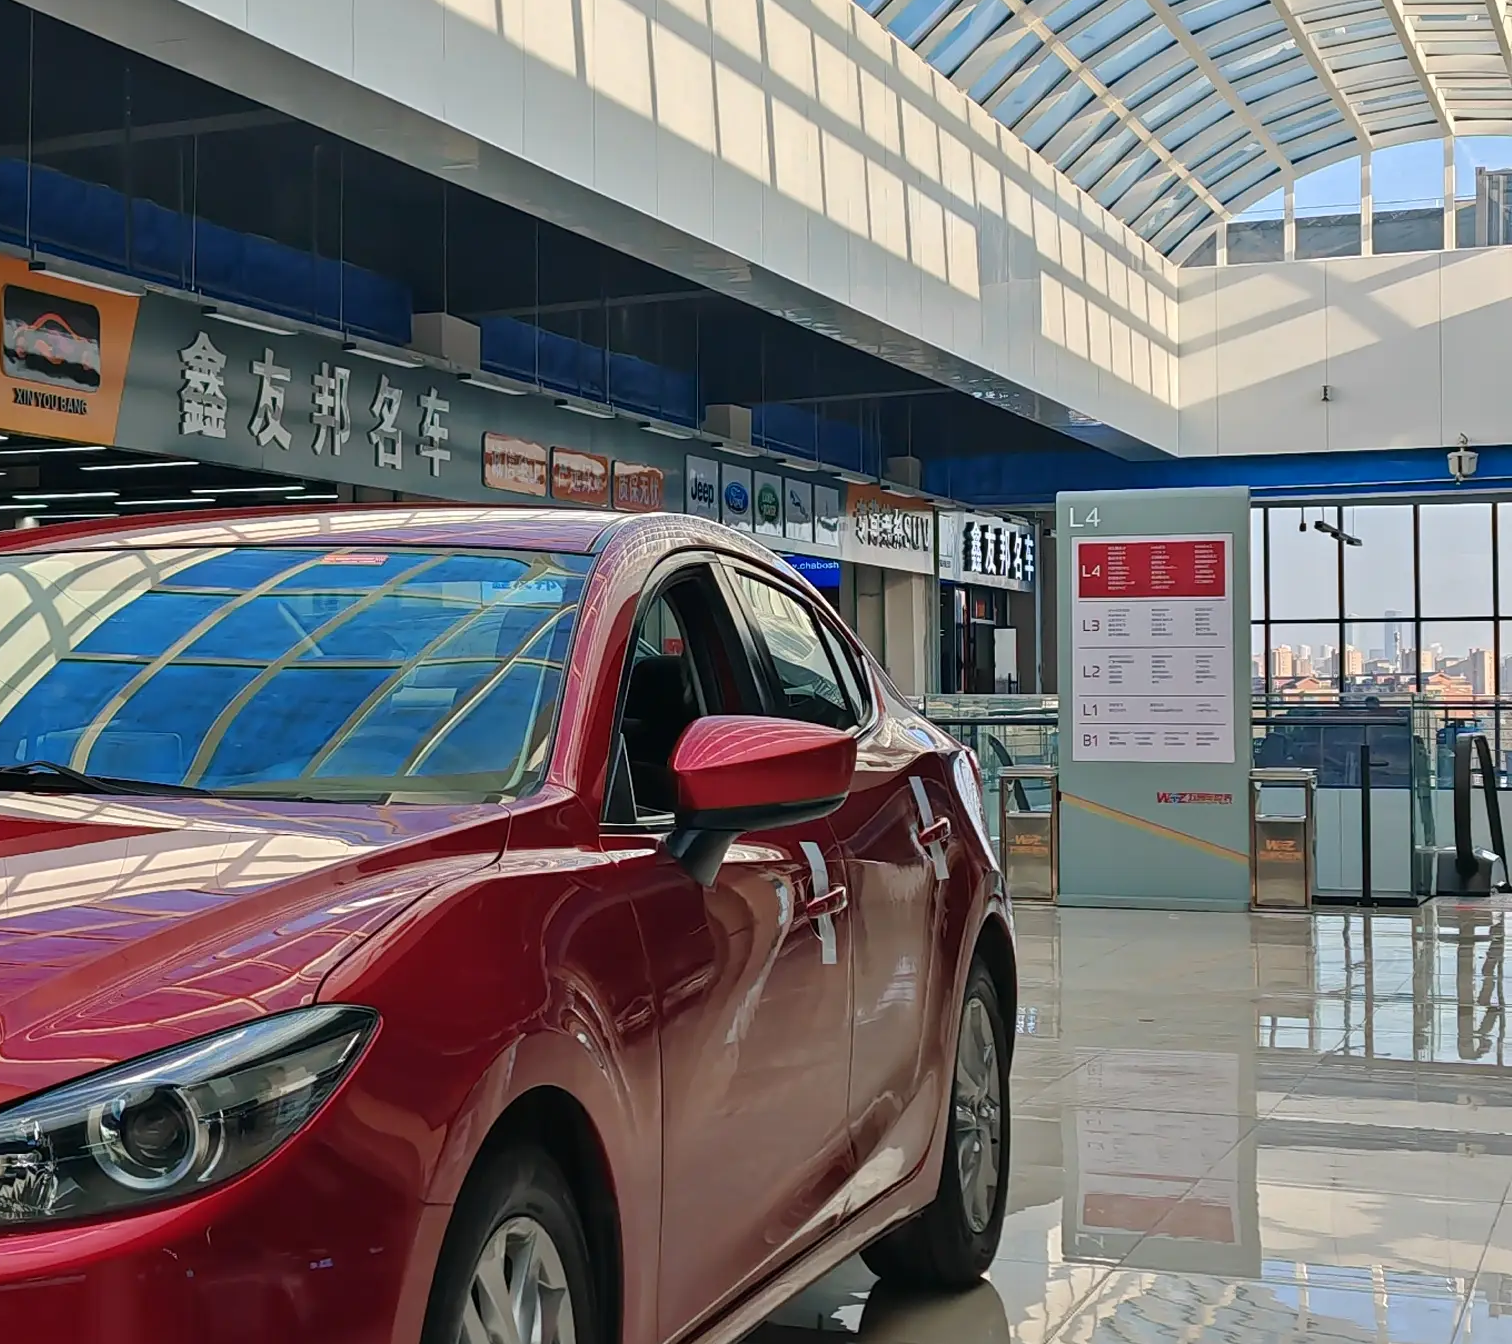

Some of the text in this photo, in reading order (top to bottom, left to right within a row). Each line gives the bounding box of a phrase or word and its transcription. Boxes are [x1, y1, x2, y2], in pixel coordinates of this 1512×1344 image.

[13, 387, 88, 415] XIN YOU BANG
[178, 331, 451, 477] 鑫友邦名车
[690, 475, 715, 509] Jeep
[1069, 507, 1101, 528] L4
[968, 520, 1035, 582] 鑫友邦名车
[1081, 564, 1101, 578] L4
[1082, 619, 1101, 632] L3
[1082, 665, 1101, 678] L2
[1082, 703, 1099, 717] L1
[1082, 734, 1099, 747] B1
